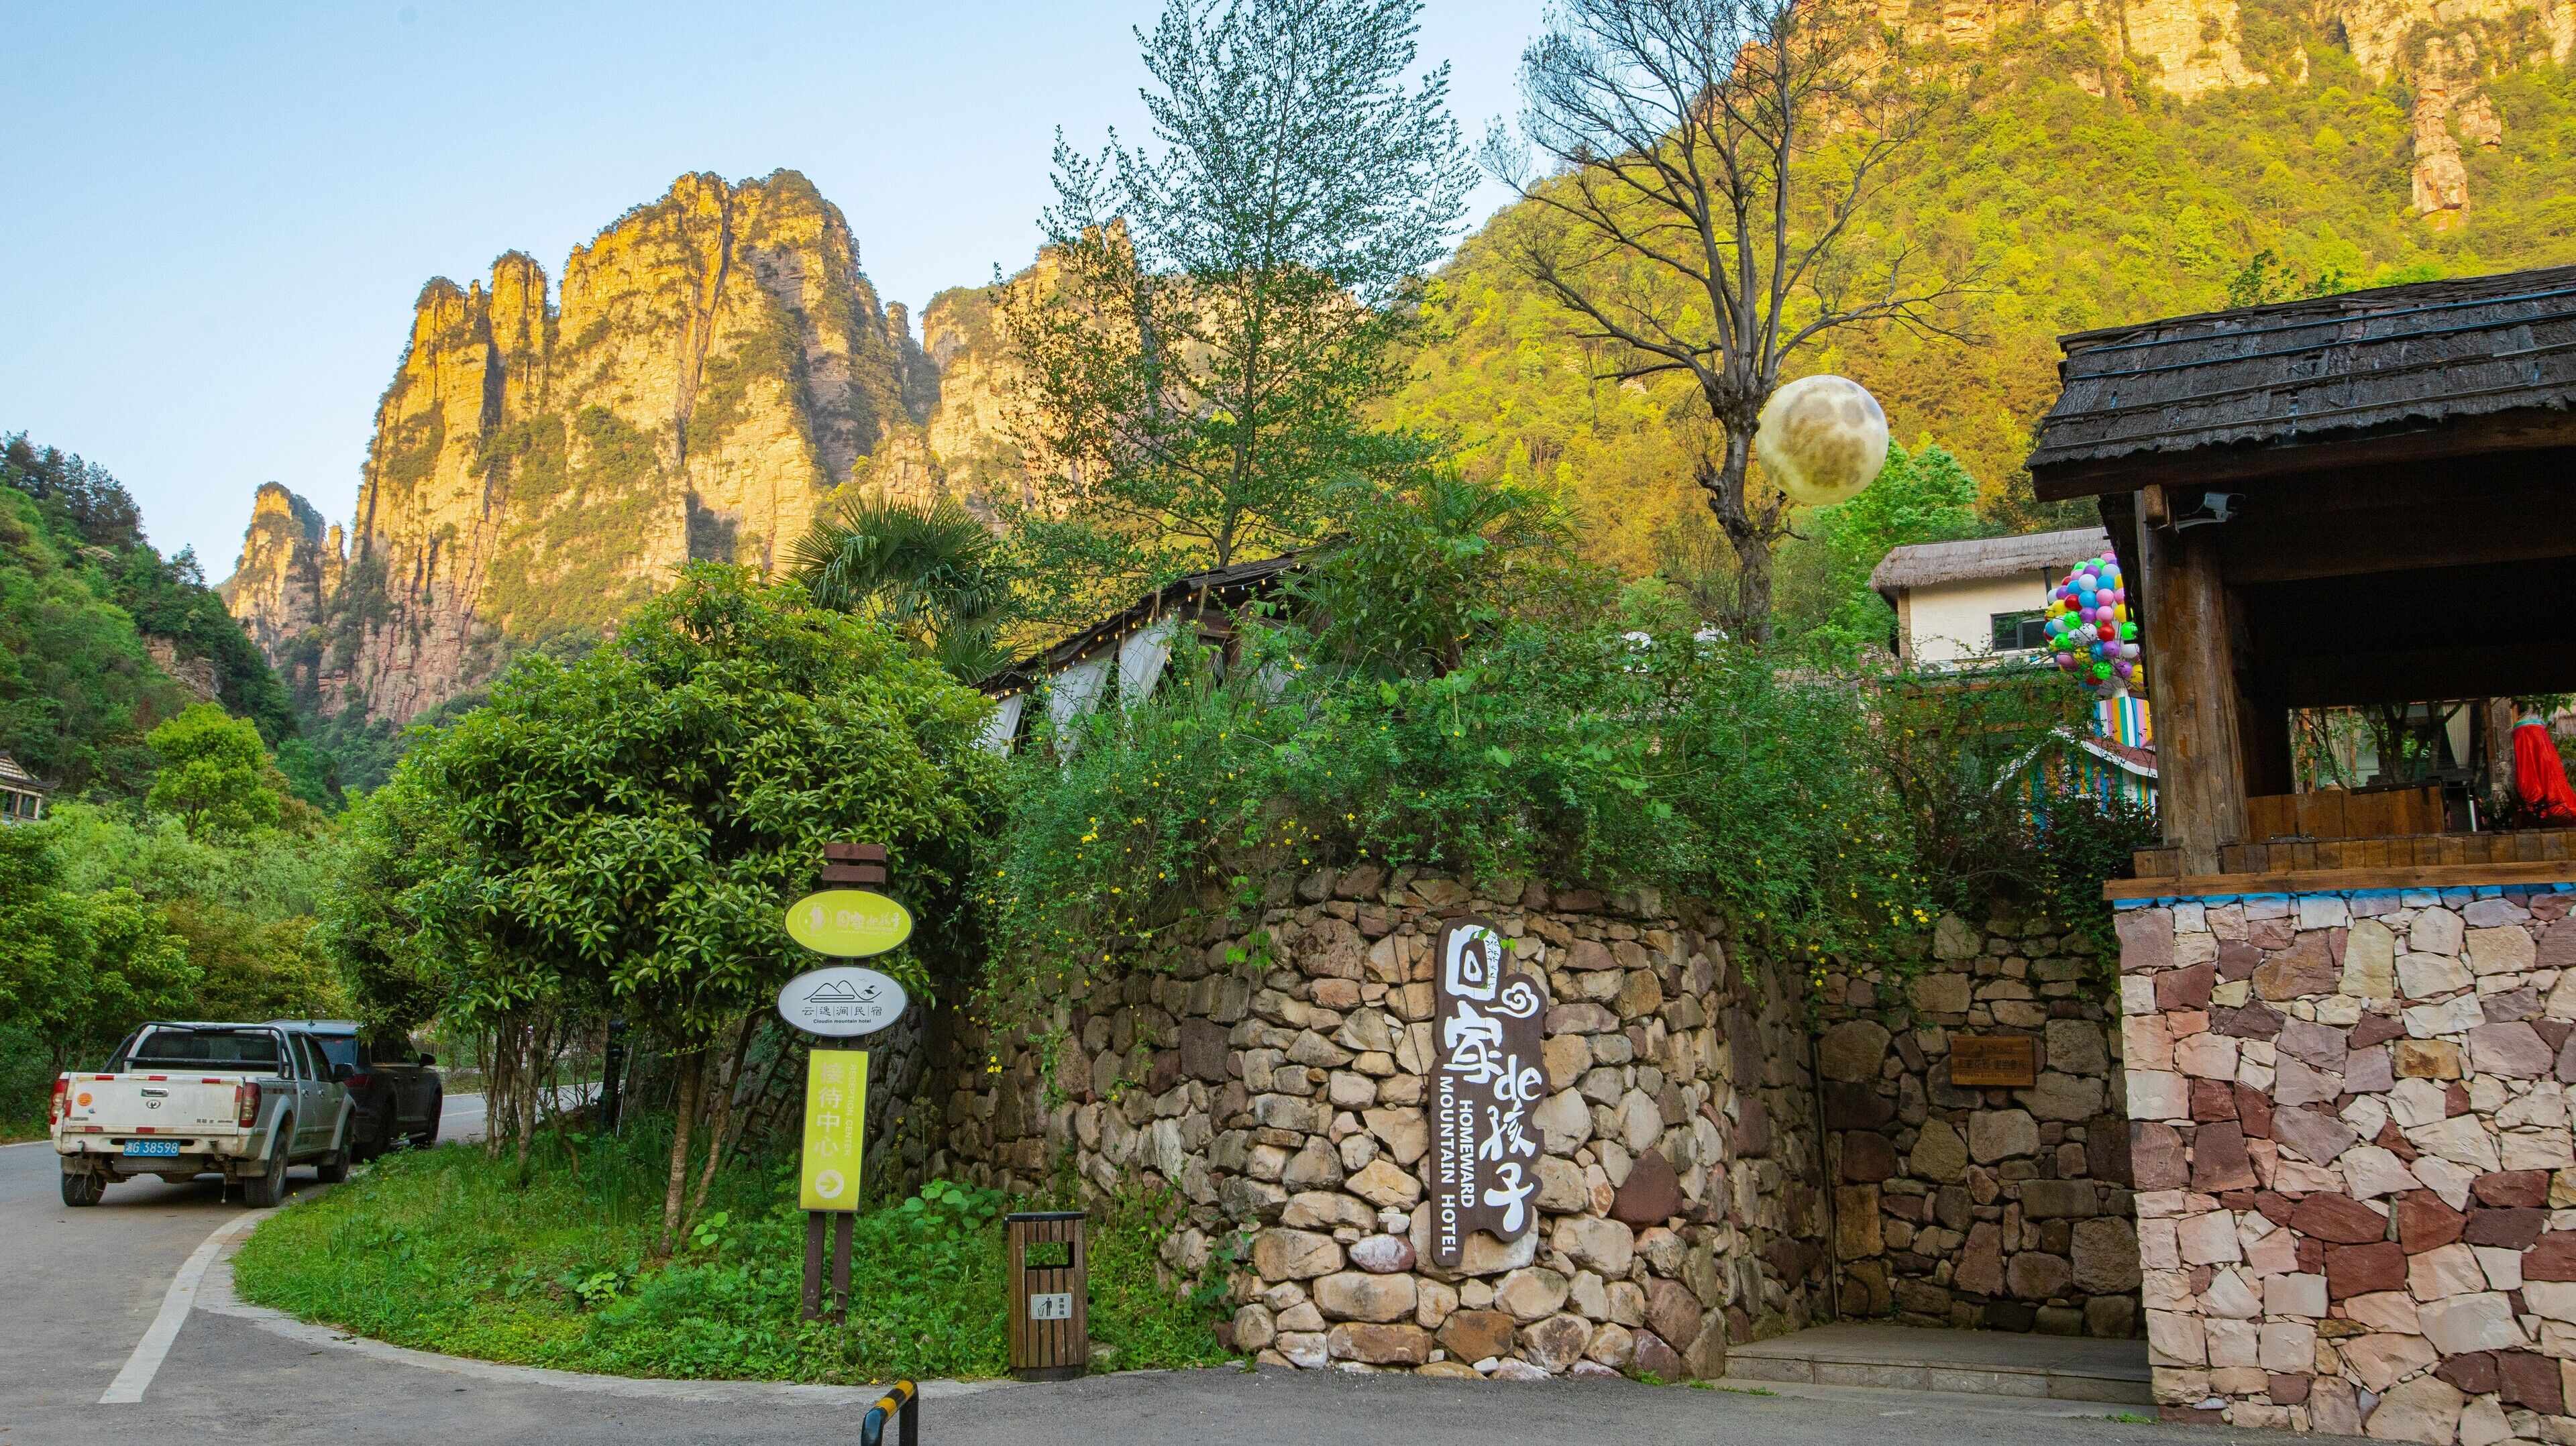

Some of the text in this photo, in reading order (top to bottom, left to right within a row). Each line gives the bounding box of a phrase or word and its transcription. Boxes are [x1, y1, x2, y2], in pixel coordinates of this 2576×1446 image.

[814, 1062, 844, 1158] 接待中心
[844, 1064, 857, 1156] RECEPTION CENTER
[1459, 1100, 1475, 1208] HOMEWARD
[1440, 1076, 1456, 1256] MOUNTAIN HOTEL
